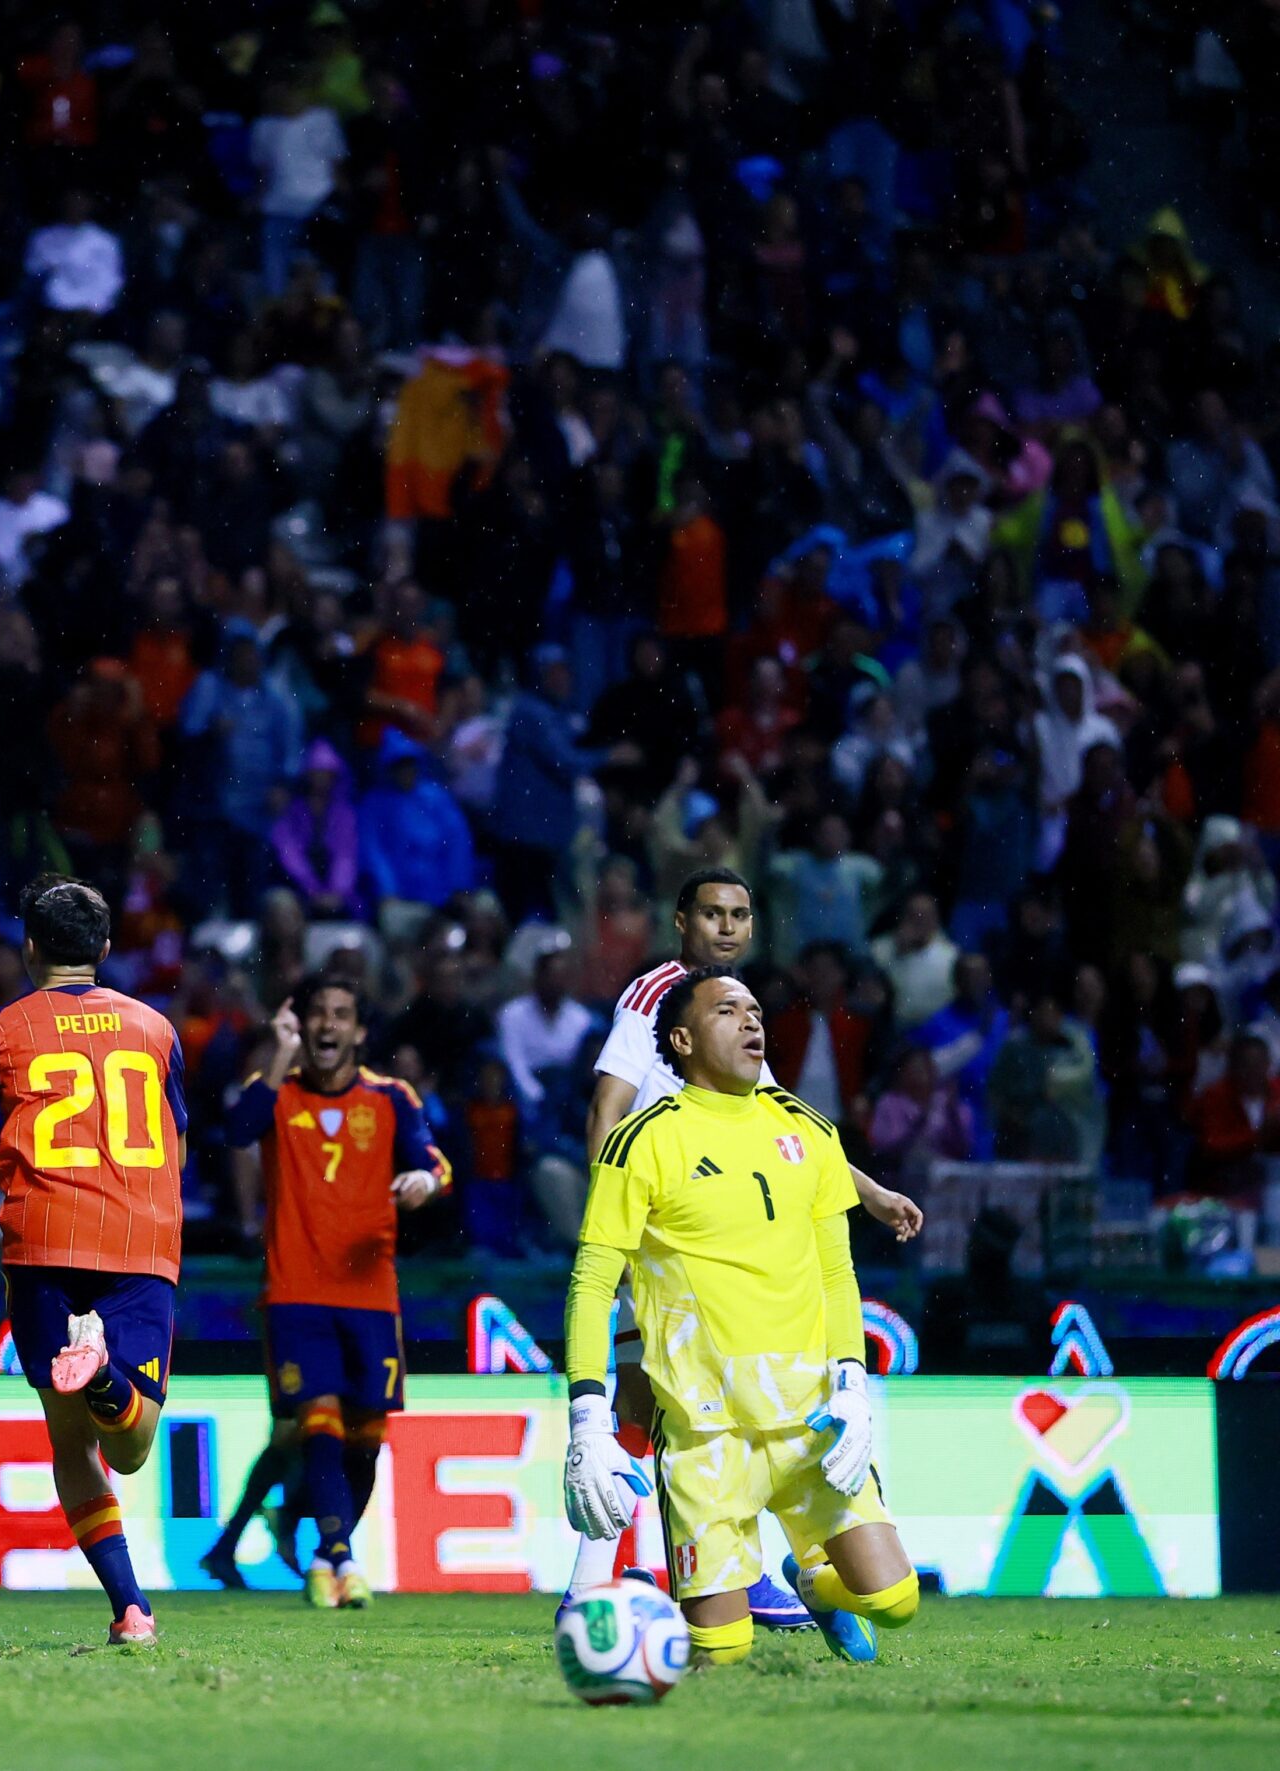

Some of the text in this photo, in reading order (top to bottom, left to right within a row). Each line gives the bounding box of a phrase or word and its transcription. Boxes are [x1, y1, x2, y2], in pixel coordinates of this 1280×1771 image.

[55, 1012, 122, 1035] PEDRI
[28, 1050, 165, 1169] 20
[322, 1142, 344, 1184] 7
[752, 1171, 775, 1222] 1
[382, 1357, 399, 1400] 7
